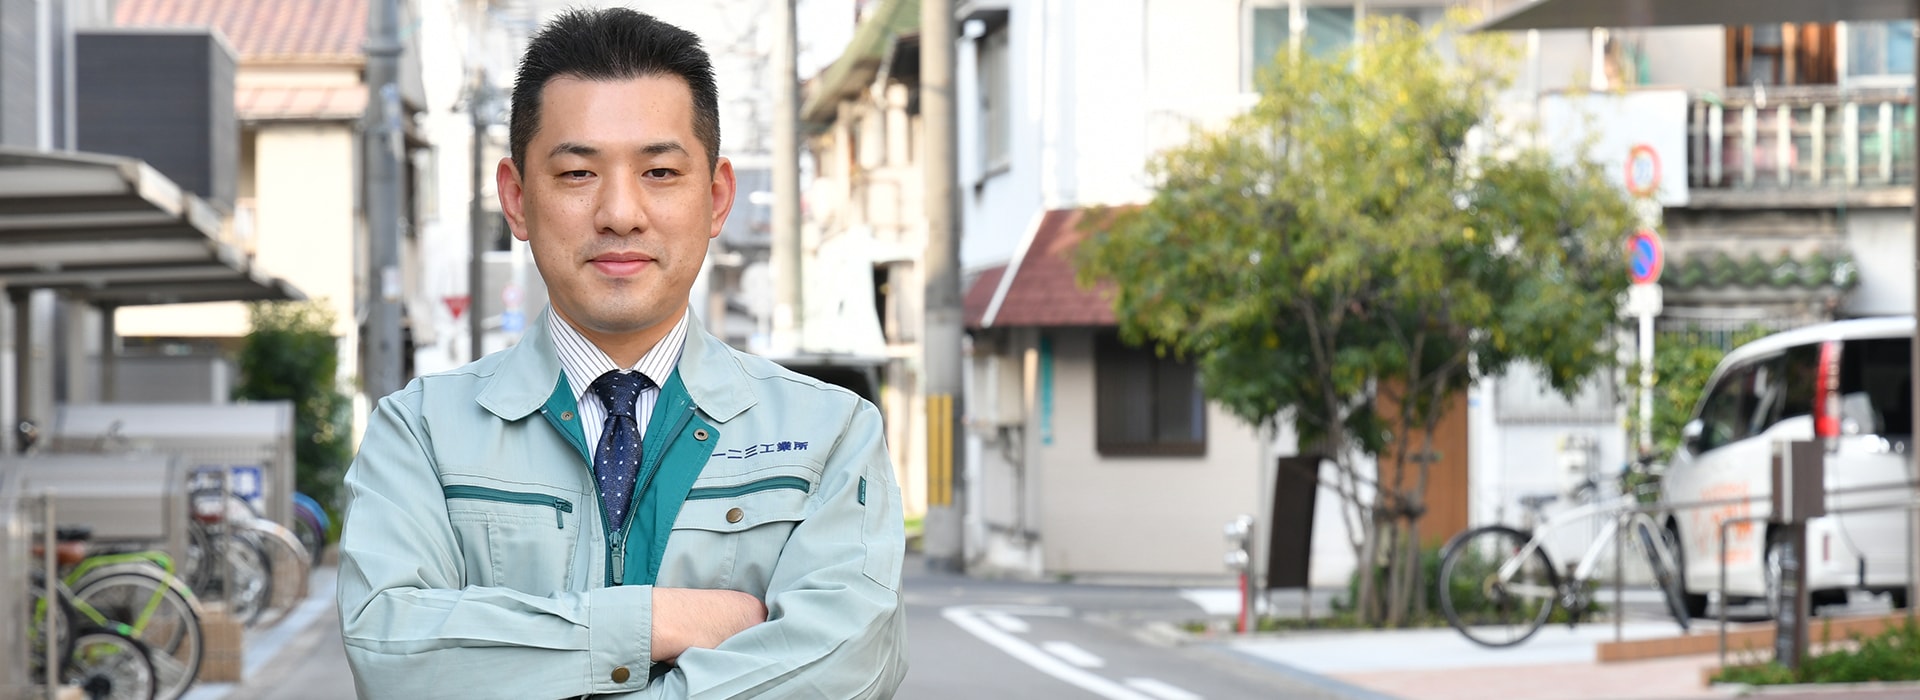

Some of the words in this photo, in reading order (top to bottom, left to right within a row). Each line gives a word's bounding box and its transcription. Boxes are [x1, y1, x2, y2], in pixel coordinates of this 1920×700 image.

[712, 441, 809, 459] 一二三工業所
